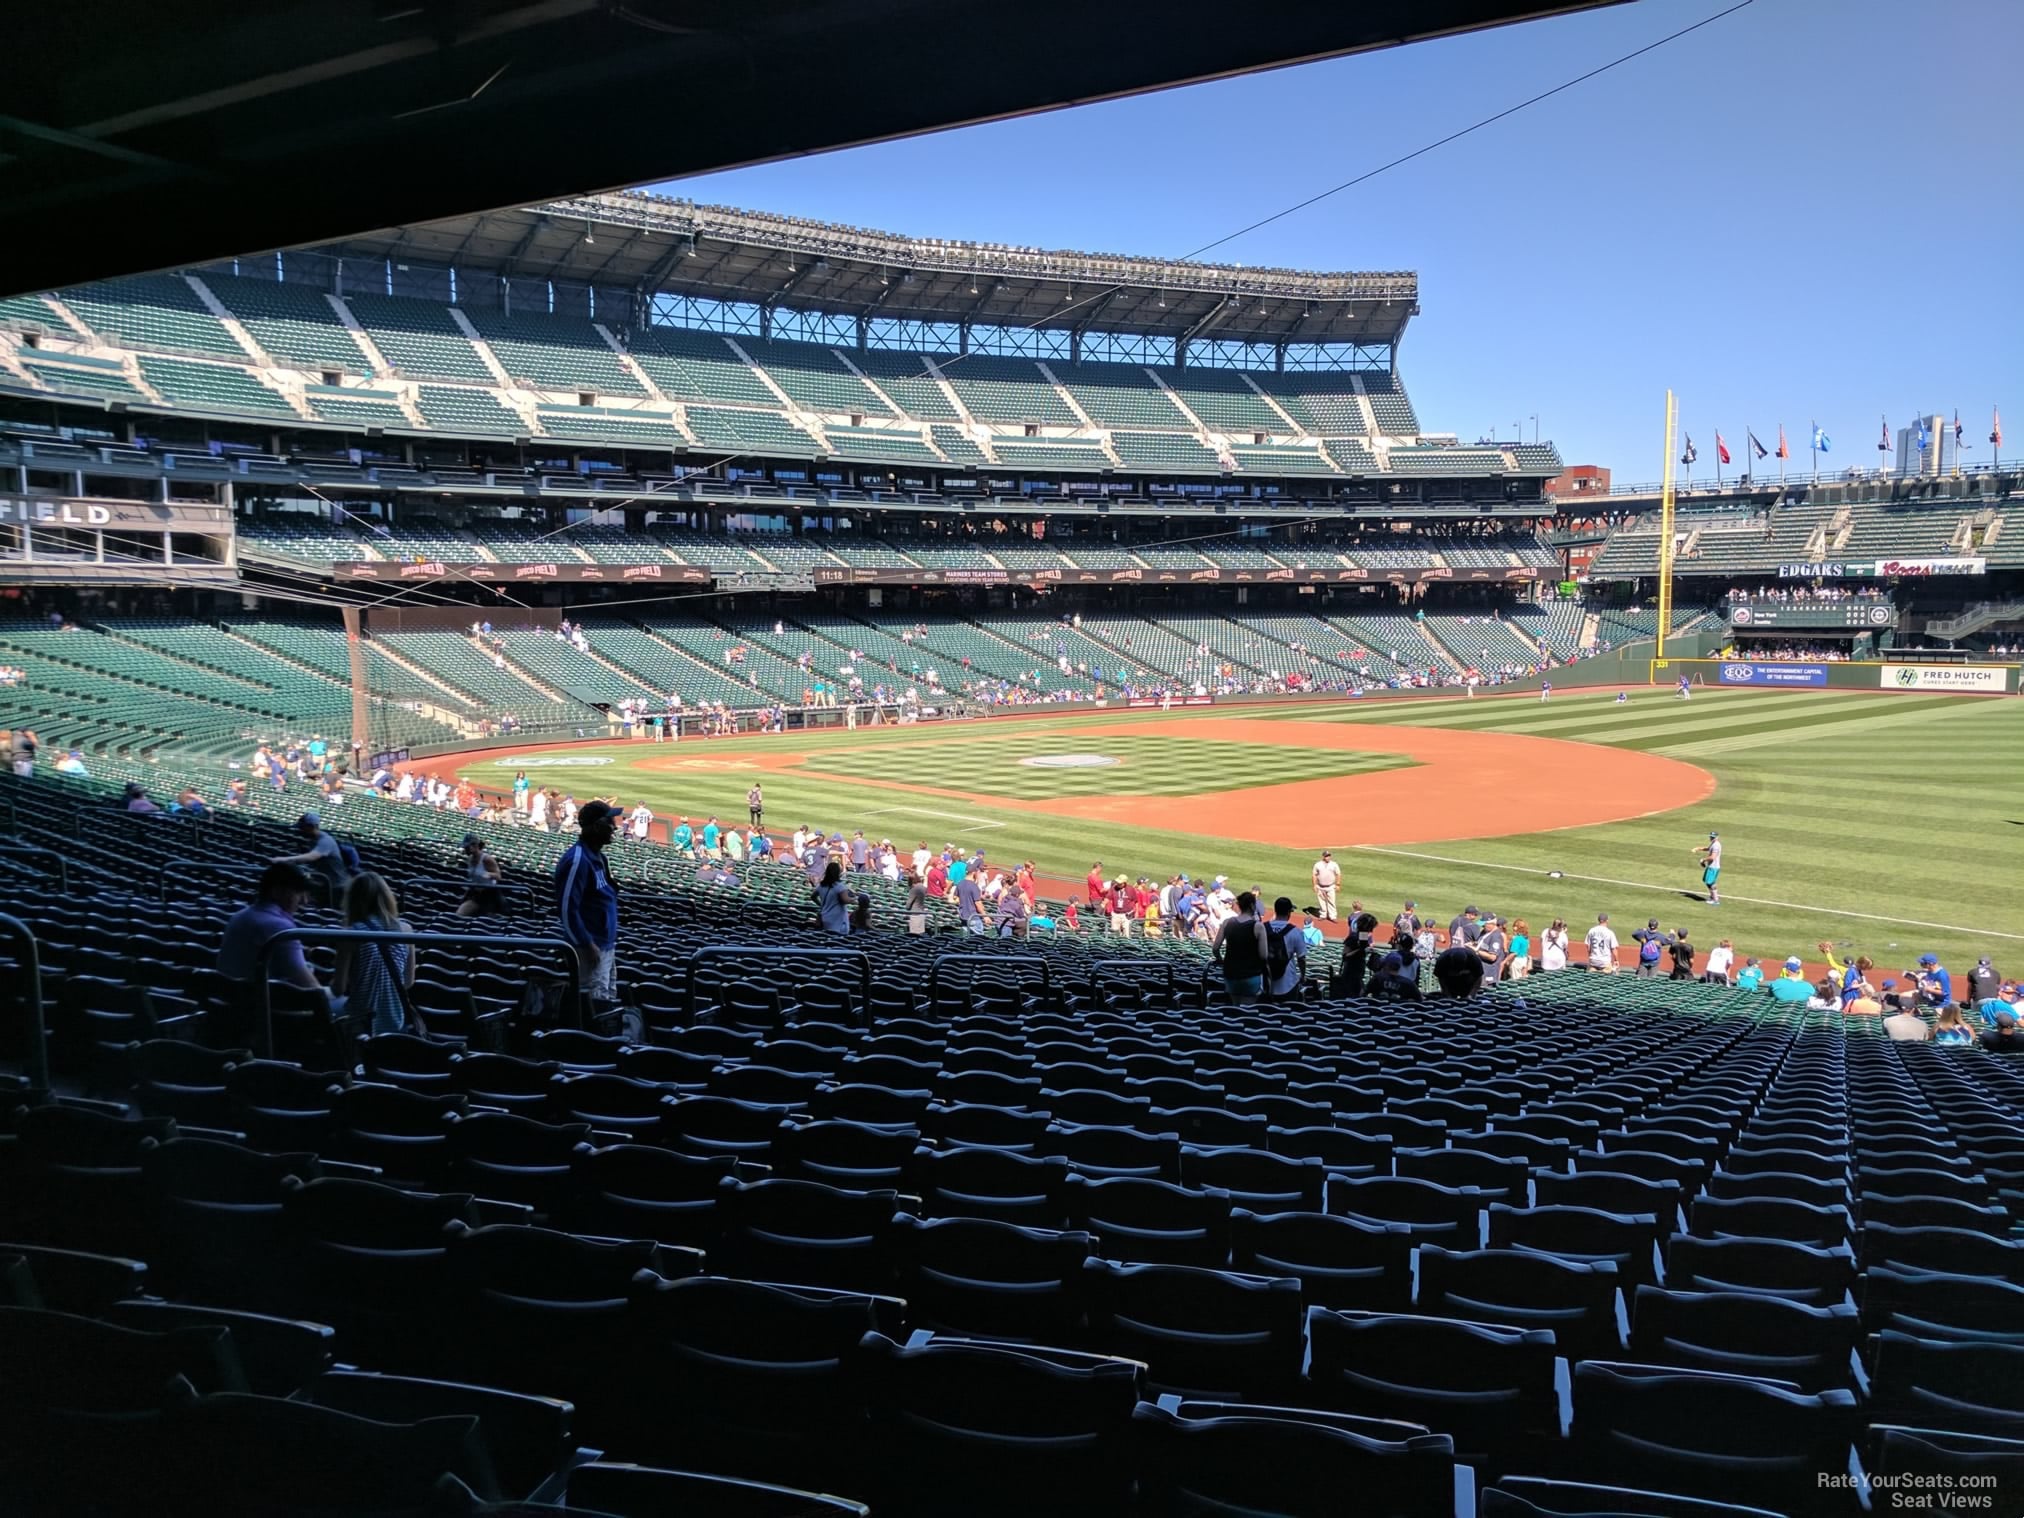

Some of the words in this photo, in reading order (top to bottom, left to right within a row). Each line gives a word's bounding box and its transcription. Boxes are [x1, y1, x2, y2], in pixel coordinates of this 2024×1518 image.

[0, 499, 110, 524] FIELD
[1883, 561, 1930, 576] Coors
[821, 571, 843, 580] 11:18
[1656, 660, 1668, 668] 331
[1924, 671, 1951, 679] FRED
[1954, 672, 1991, 680] HUTCH
[807, 855, 814, 865] 3
